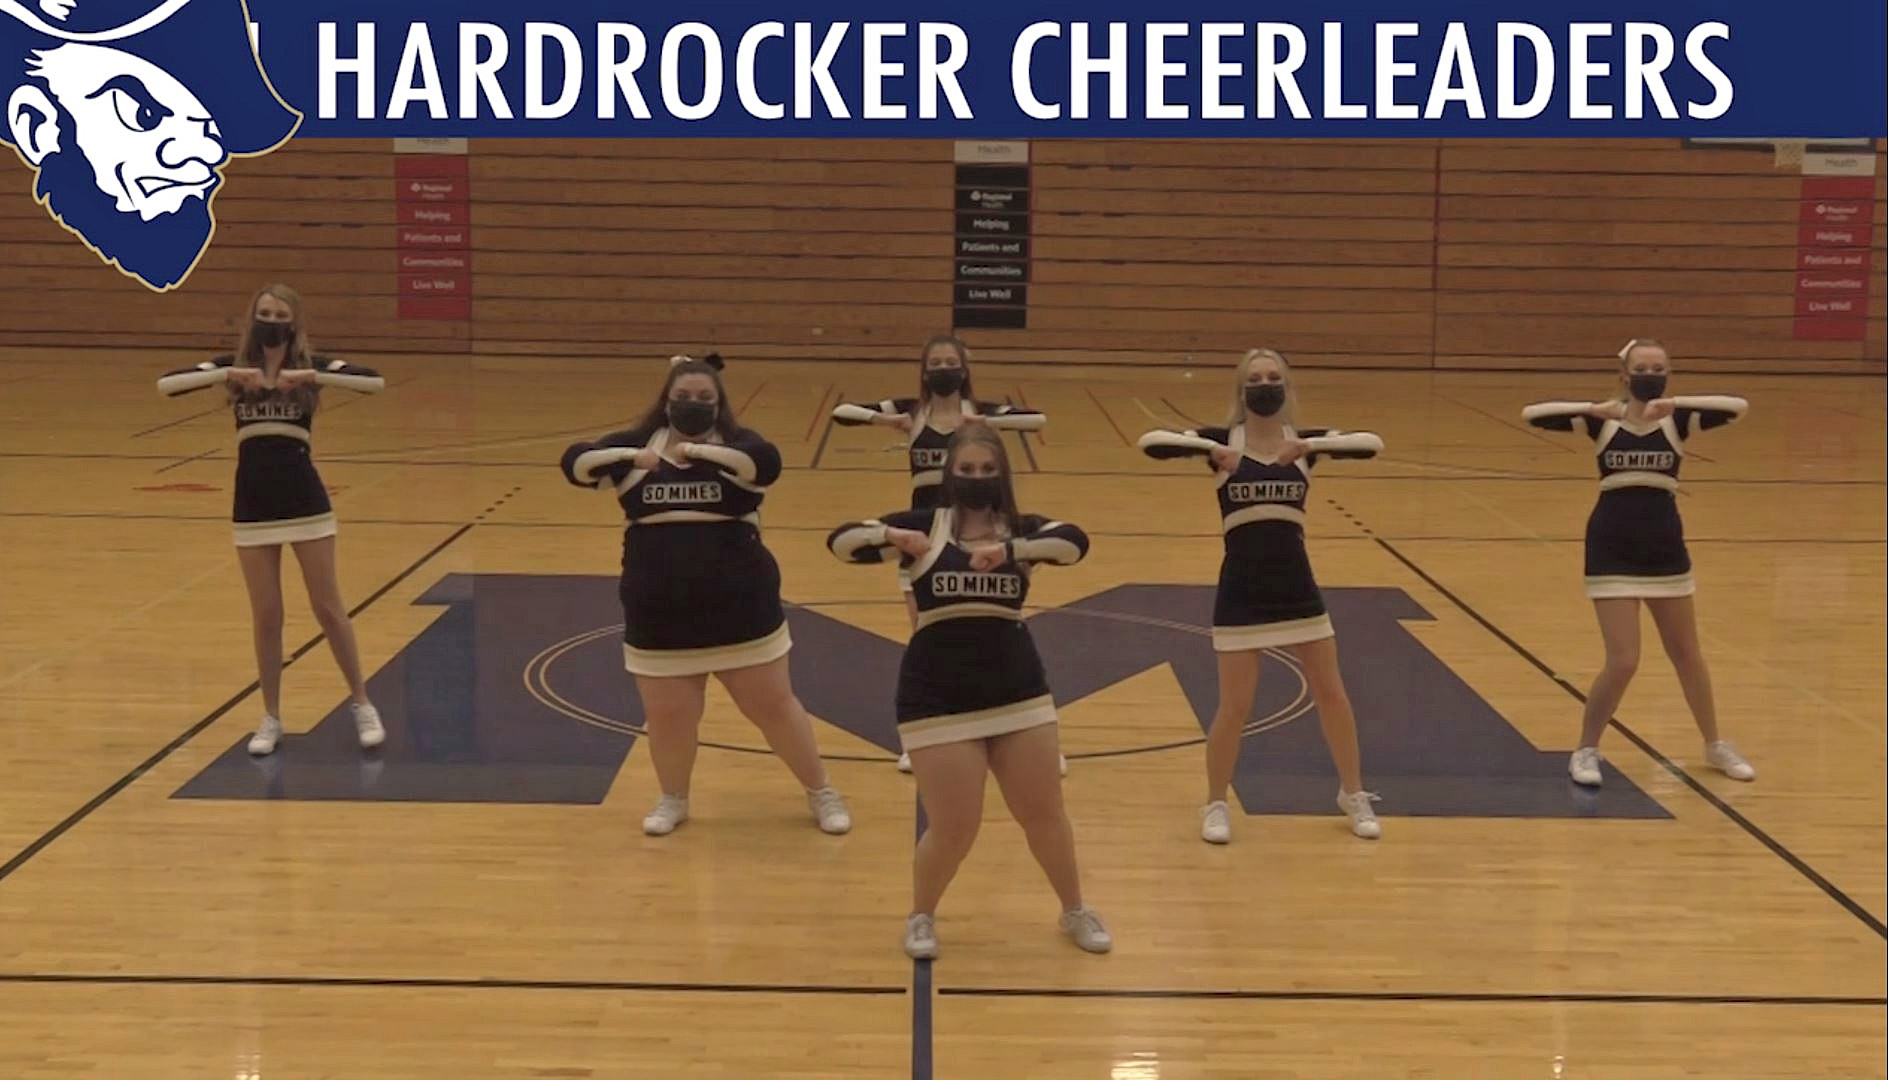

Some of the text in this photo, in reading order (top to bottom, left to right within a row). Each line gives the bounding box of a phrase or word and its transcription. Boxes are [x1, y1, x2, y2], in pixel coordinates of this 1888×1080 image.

[415, 211, 451, 222] Helping
[973, 219, 1010, 231] Helping
[404, 232, 462, 243] Patients and
[1816, 231, 1853, 243] Helping
[961, 241, 1020, 253] Patients and
[402, 257, 465, 267] Communities
[1804, 255, 1862, 265] Patients and
[960, 265, 1022, 275] Communities
[412, 279, 455, 290] Live Well
[1801, 279, 1862, 289] Communities
[969, 289, 1012, 299] Live Well
[1809, 301, 1852, 312] Live Well
[1627, 452, 1674, 469] MINES
[667, 482, 721, 502] MINES
[1254, 482, 1305, 501] MINES
[934, 574, 1019, 596] SD MINES
